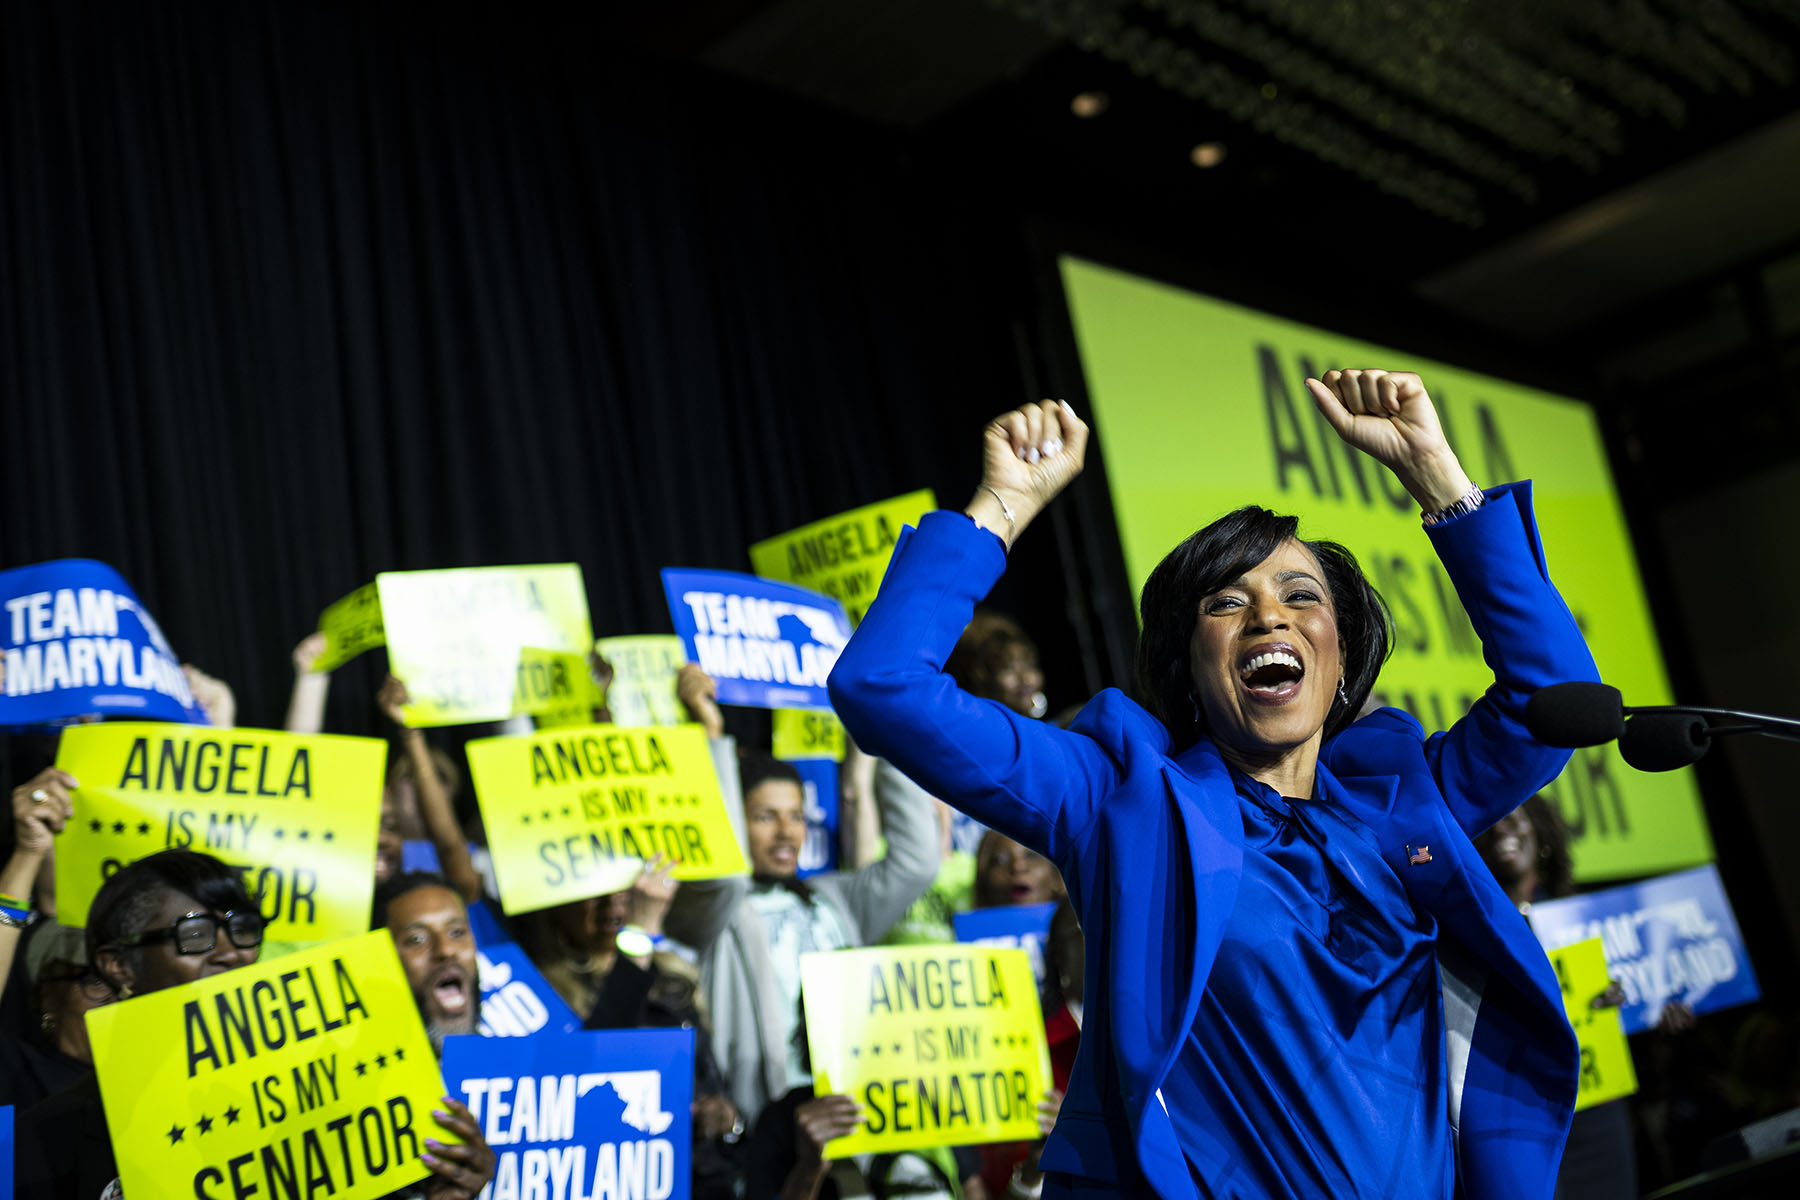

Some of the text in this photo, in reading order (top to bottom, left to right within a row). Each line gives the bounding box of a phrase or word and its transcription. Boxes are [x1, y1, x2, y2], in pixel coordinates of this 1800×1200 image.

[787, 515, 896, 578] ANGELA
[6, 588, 119, 645] TEAM
[683, 591, 780, 640] TEAM
[694, 632, 841, 688] MARYLA
[119, 738, 311, 798] ANGELA
[535, 735, 672, 785] ANGELA
[166, 811, 258, 849] IS MY
[580, 787, 646, 820] IS MY
[539, 823, 711, 886] SENATOR
[869, 959, 1009, 1013] ANGELA
[184, 958, 369, 1078] ANGELA
[913, 1025, 983, 1062] IS MY
[251, 1054, 339, 1129] IS MY
[461, 1074, 577, 1145] TEAM
[865, 1070, 1031, 1134] SENATOR
[478, 1138, 674, 1200] ARYLAND
